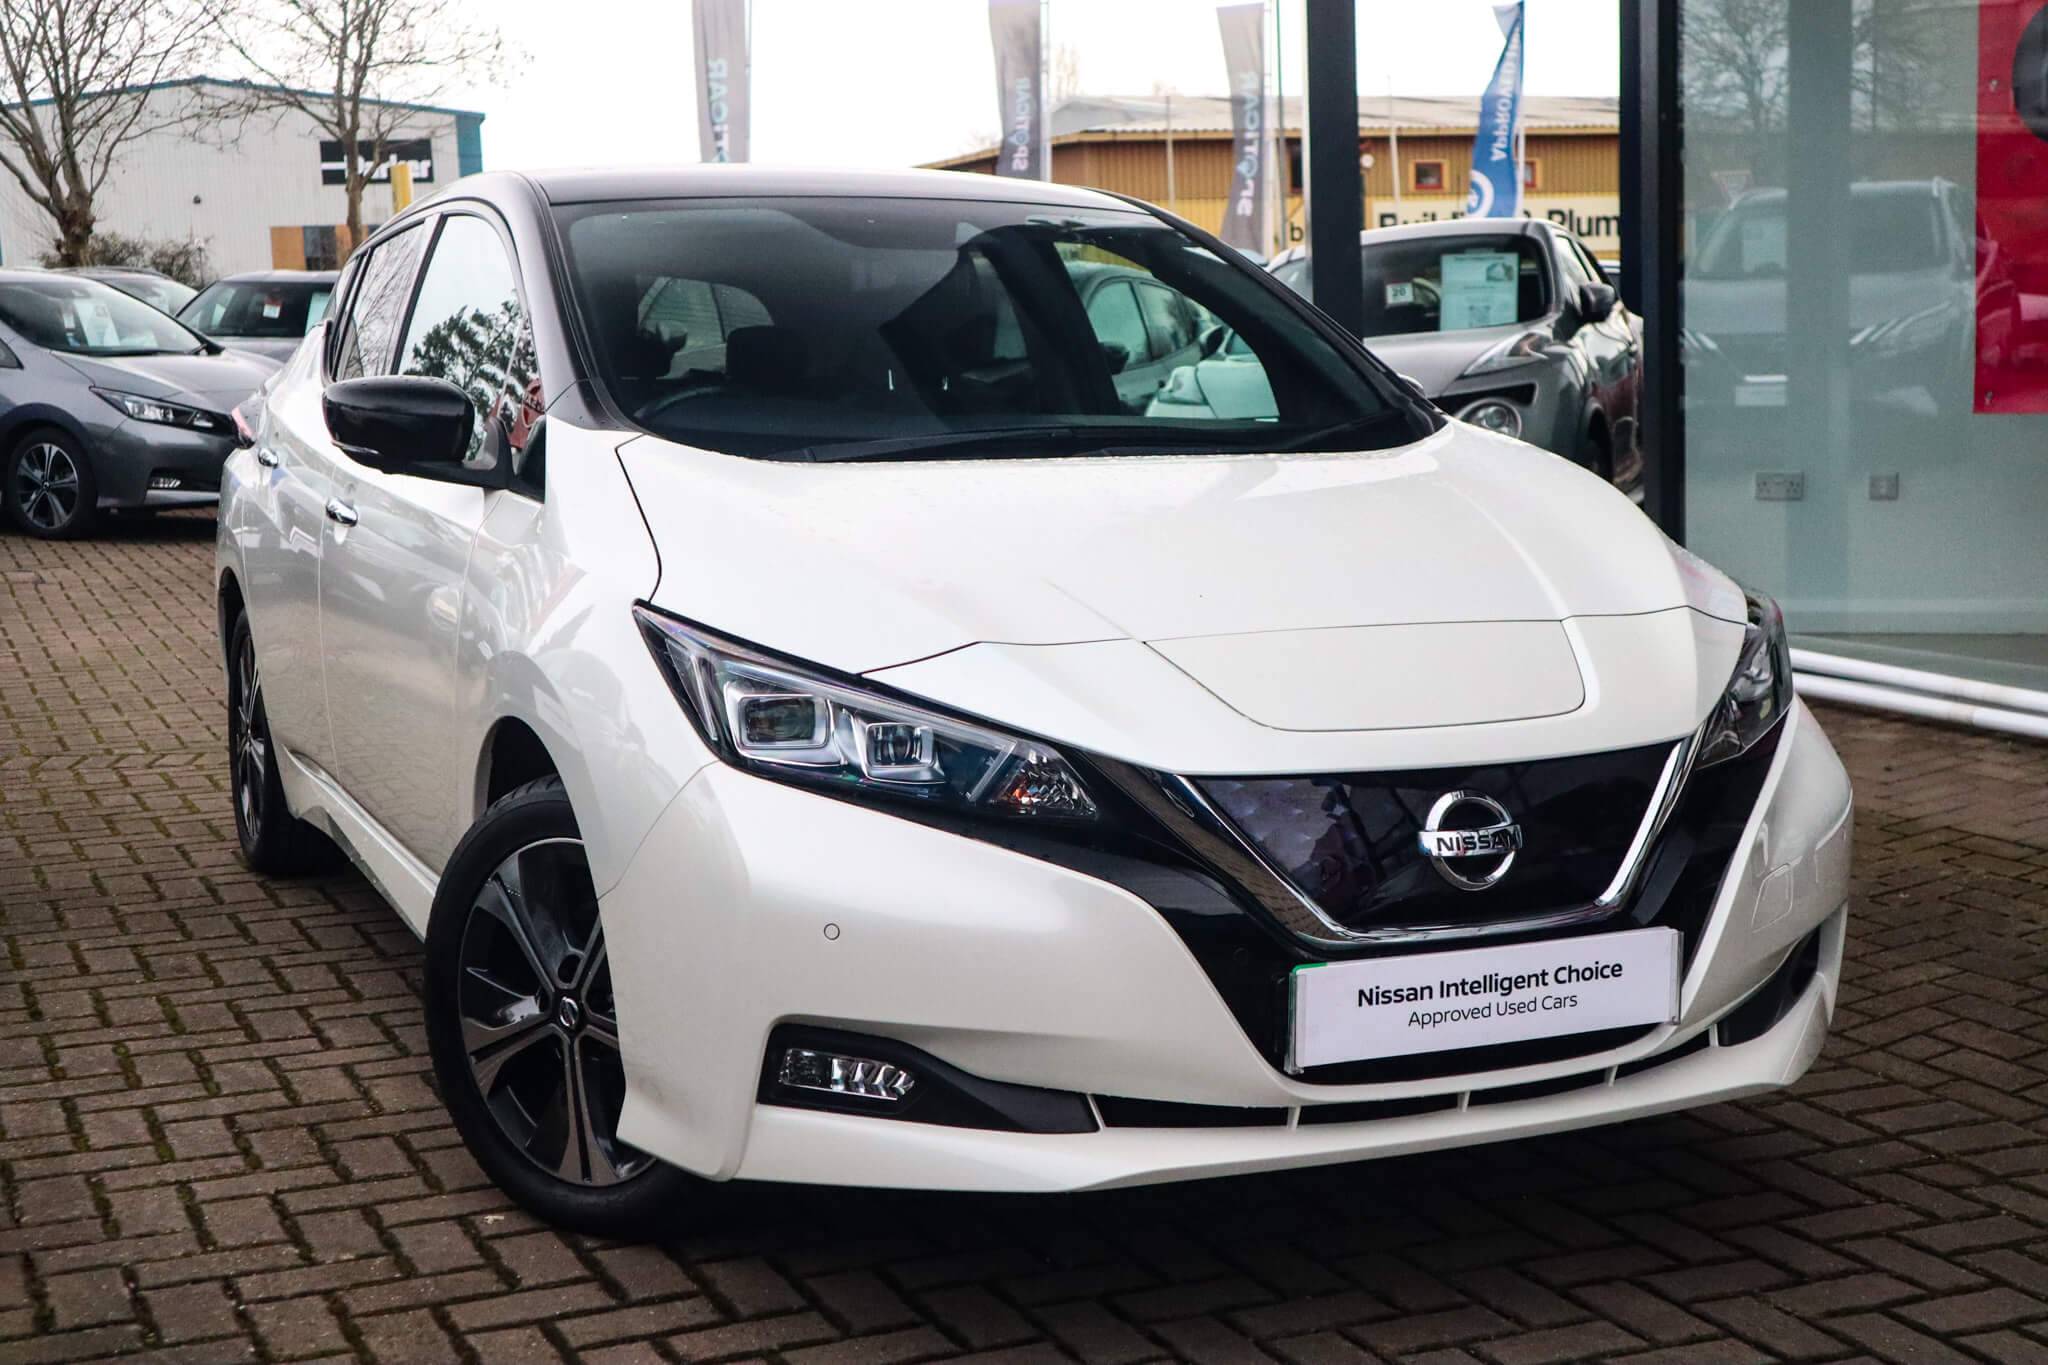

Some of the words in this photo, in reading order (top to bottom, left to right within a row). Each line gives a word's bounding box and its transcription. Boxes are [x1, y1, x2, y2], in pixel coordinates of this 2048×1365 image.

[1436, 826, 1521, 852] NISSAN
[1358, 986, 1432, 1007] Nissan
[1439, 969, 1549, 996] Intelligent
[1553, 961, 1623, 984] Choice
[1408, 1004, 1491, 1029] Approved
[1496, 998, 1536, 1016] Used
[1541, 994, 1578, 1011] Cars
